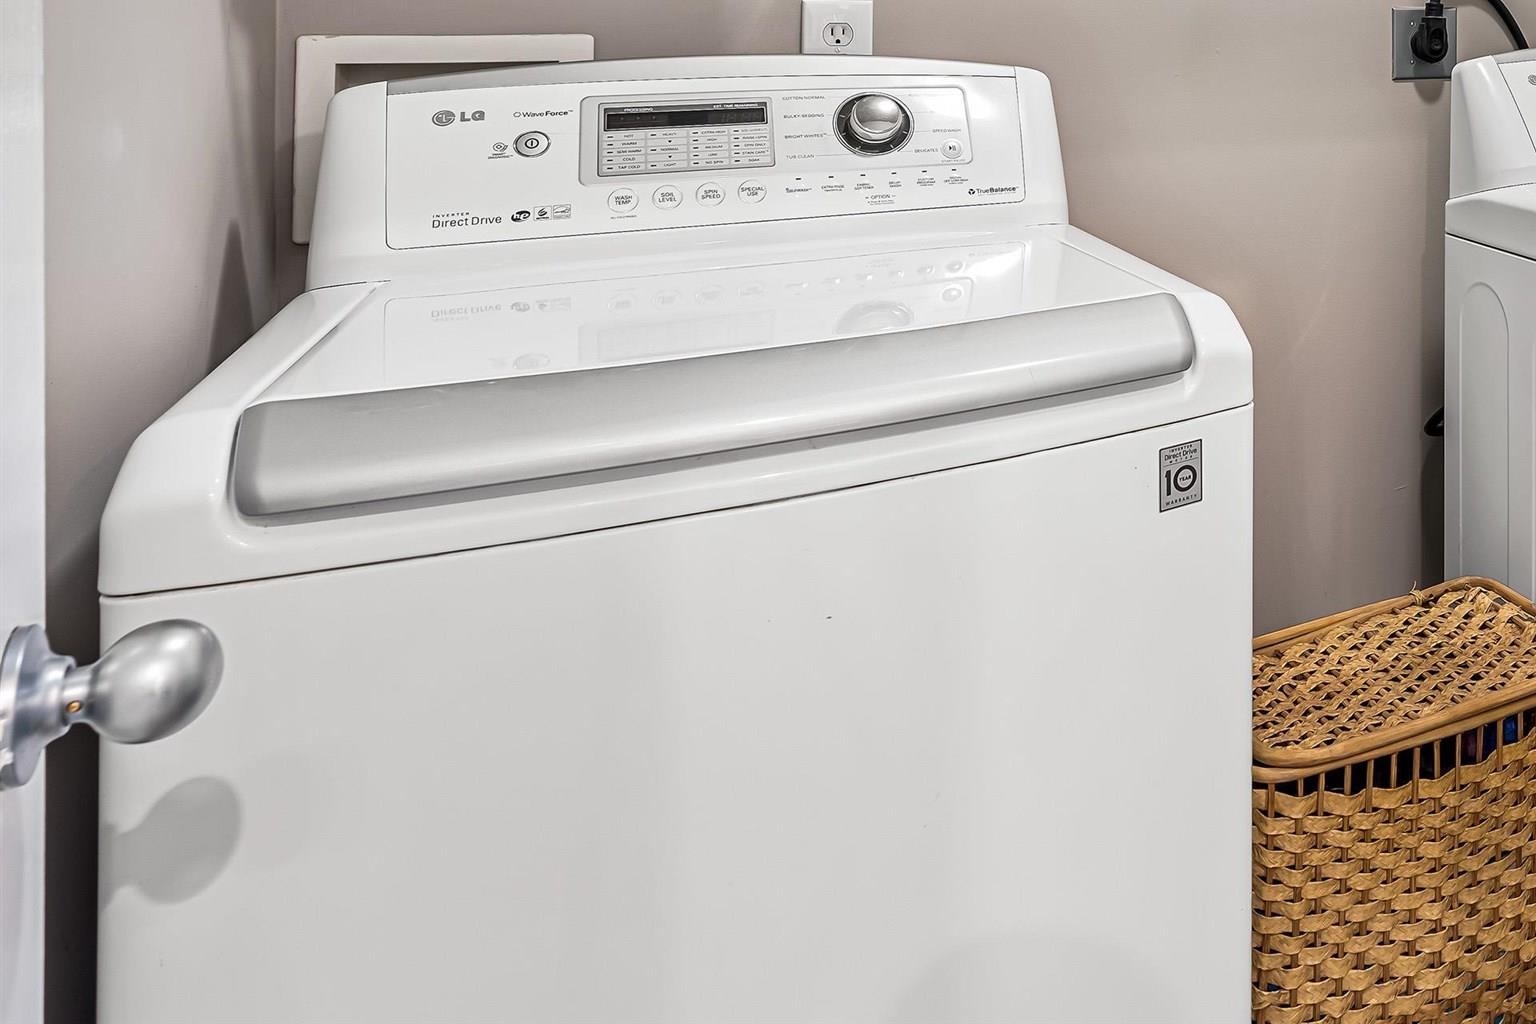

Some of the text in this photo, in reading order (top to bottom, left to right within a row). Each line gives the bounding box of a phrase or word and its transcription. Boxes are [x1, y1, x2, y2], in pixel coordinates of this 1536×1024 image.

[460, 110, 485, 122] LG
[432, 215, 502, 228] Direct Drive
[1164, 452, 1182, 461] Direct
[1182, 448, 1198, 456] Drive
[1164, 464, 1198, 497] 10
